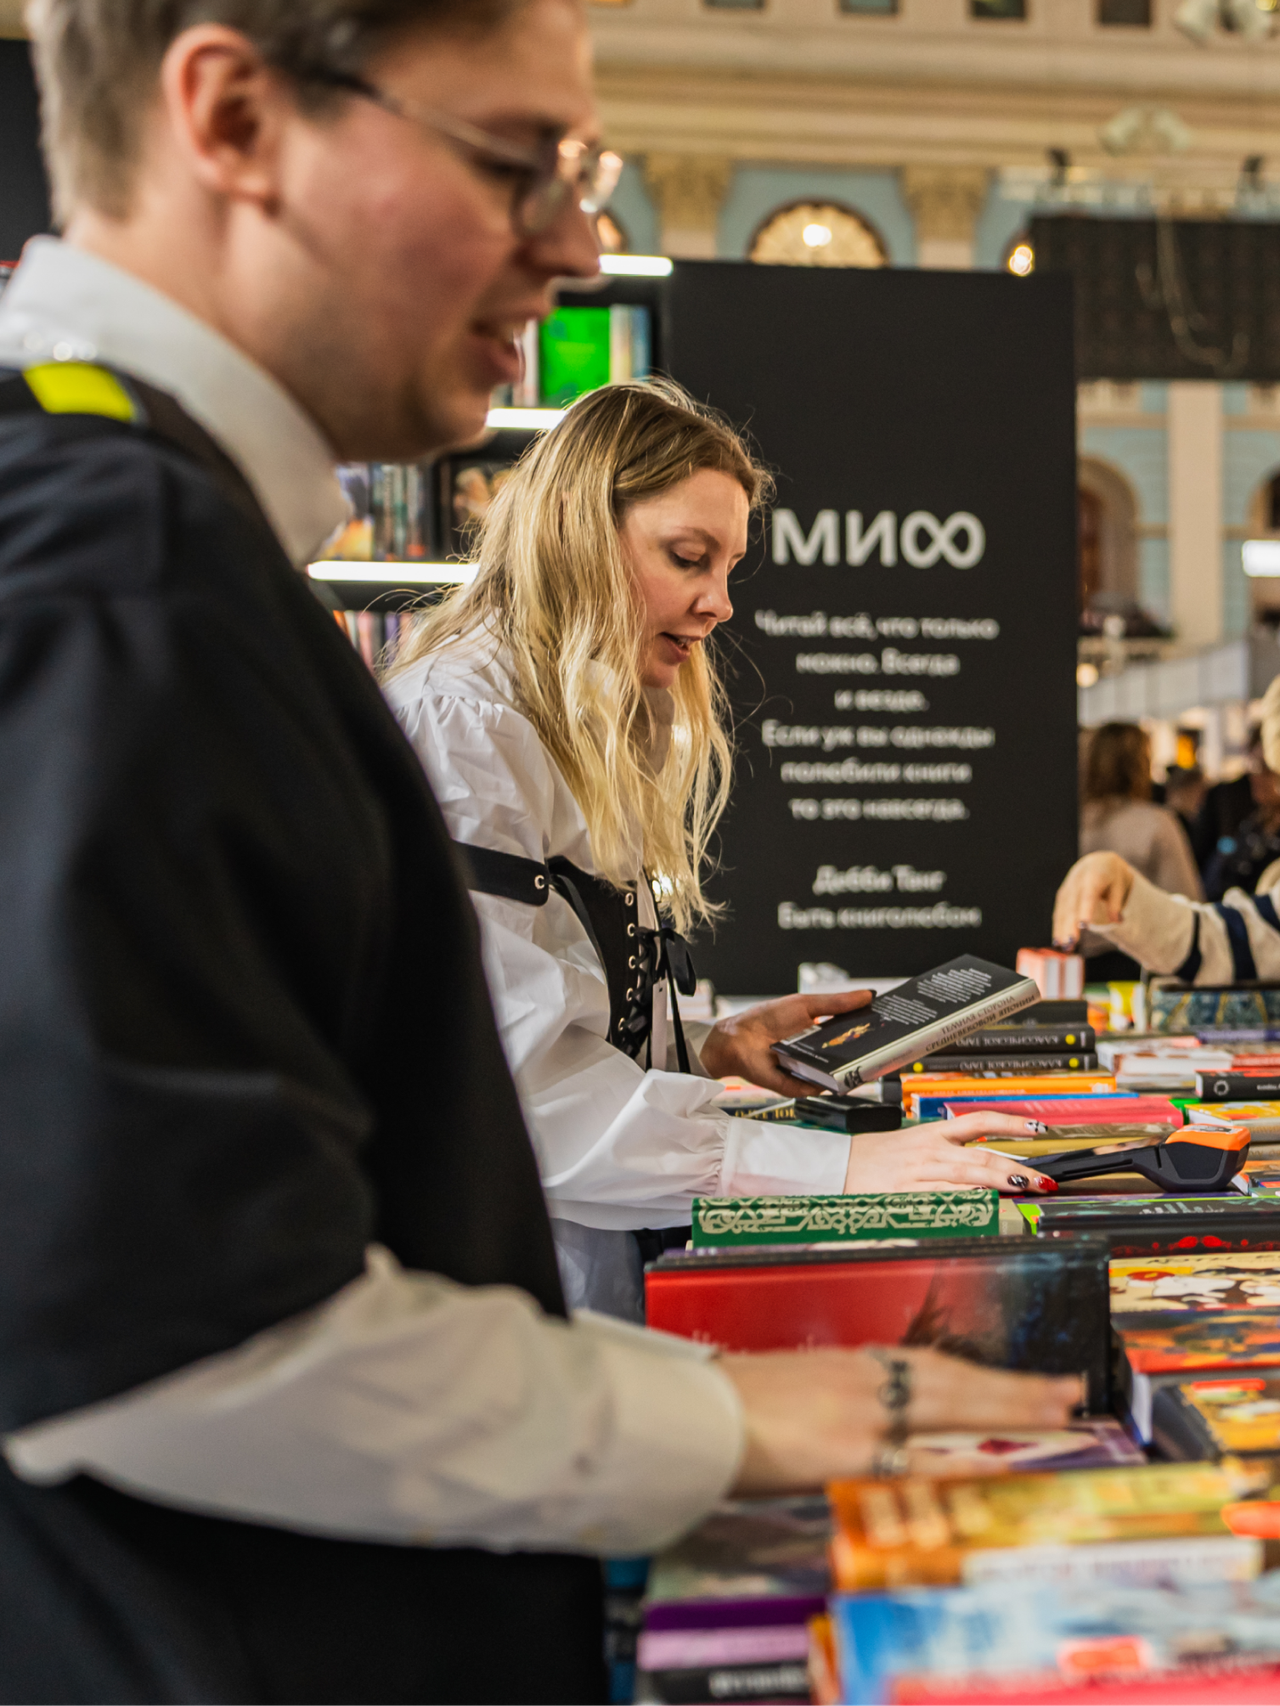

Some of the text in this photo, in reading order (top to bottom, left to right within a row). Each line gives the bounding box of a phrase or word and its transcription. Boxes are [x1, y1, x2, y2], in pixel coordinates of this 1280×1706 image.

[755, 610, 828, 637] Читай
[876, 617, 919, 639] что
[920, 618, 999, 639] только
[881, 648, 960, 677] Всегда
[834, 689, 853, 710] и
[762, 719, 820, 747] Если
[788, 799, 820, 820] то
[821, 799, 862, 820] это
[926, 995, 1036, 1051] СРЕДНЕВЕКОВОЙ ЯПОНИИ
[941, 995, 1015, 1034] ТЕМНАЯ СТОРОНА
